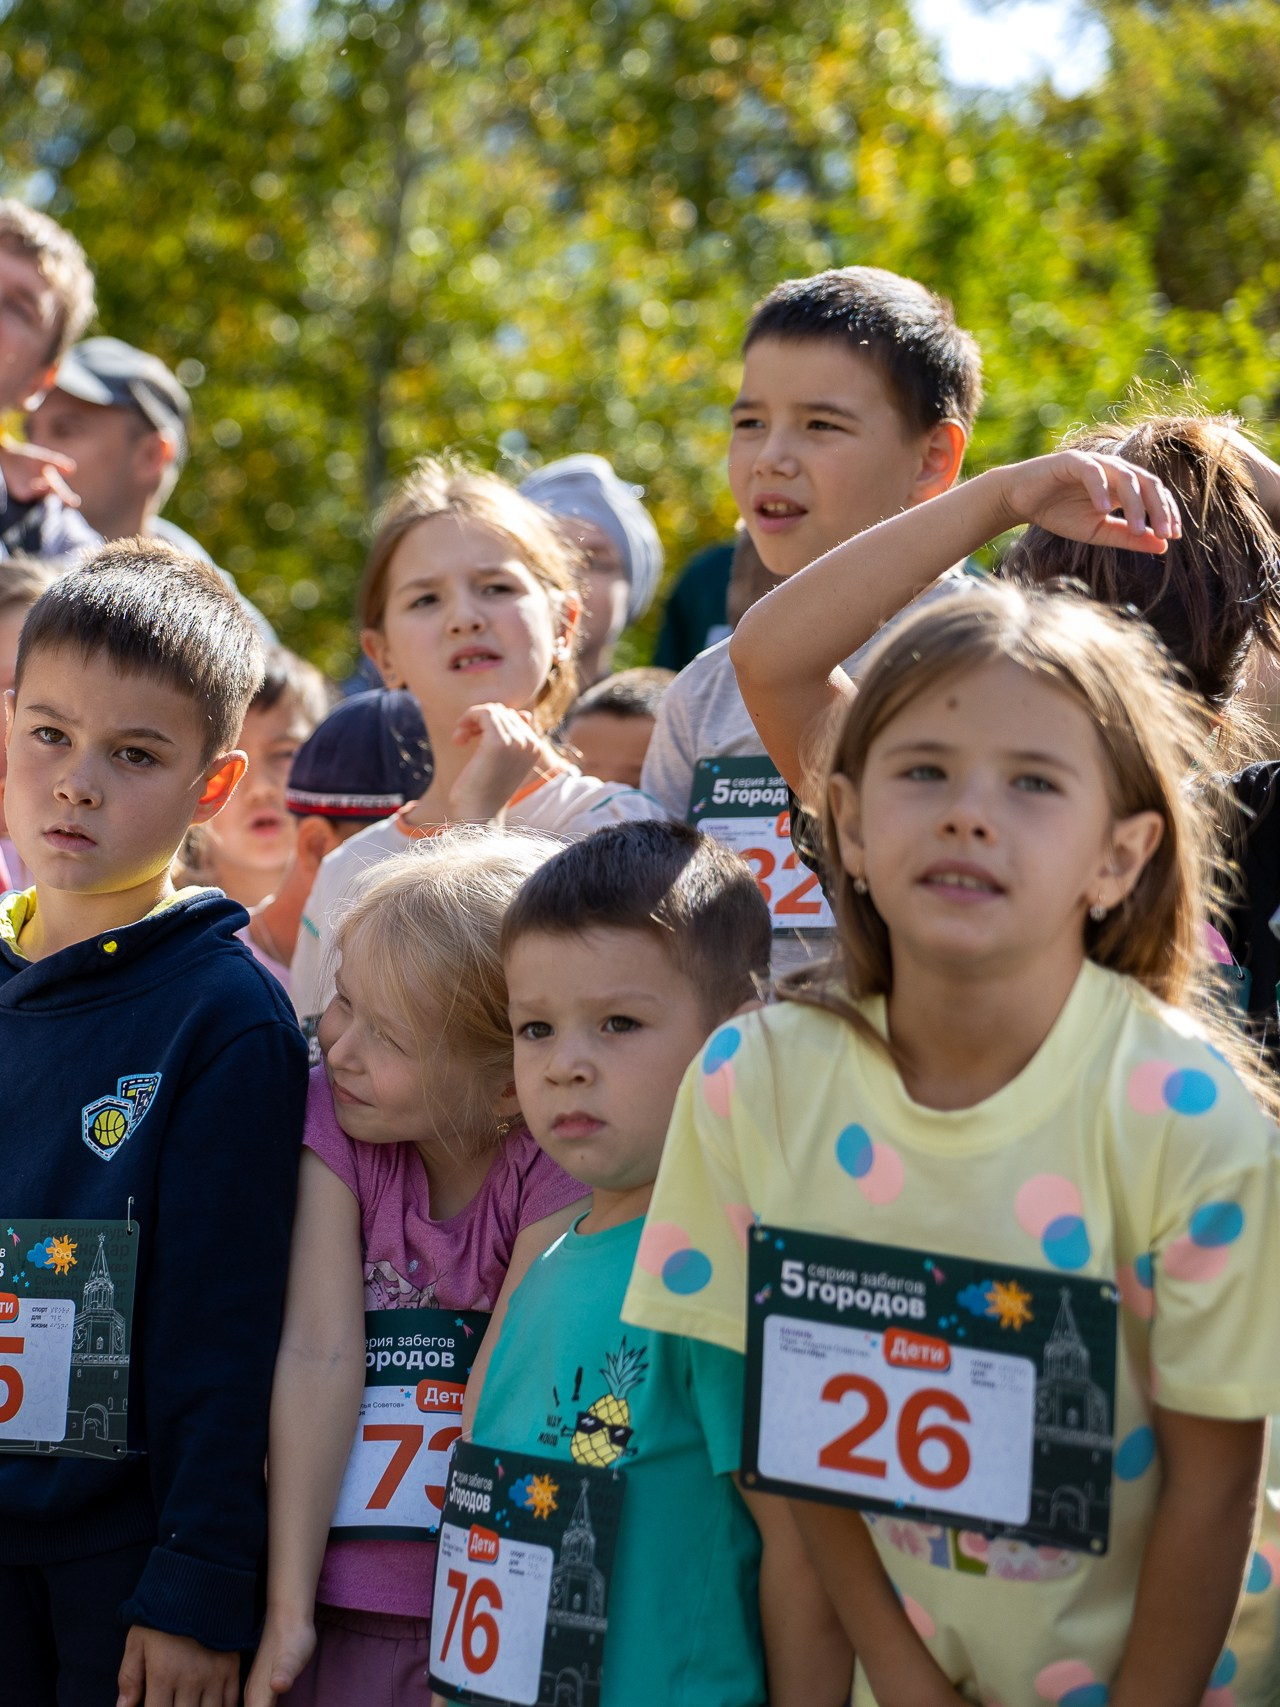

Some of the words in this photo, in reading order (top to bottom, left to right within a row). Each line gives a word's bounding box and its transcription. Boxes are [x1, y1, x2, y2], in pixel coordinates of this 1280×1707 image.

[712, 778, 731, 805] 5
[729, 788, 789, 807] город
[732, 776, 765, 788] серия
[780, 1260, 804, 1298] 5
[807, 1281, 927, 1320] городов
[807, 1264, 856, 1284] серия
[860, 1271, 926, 1296] забегов
[397, 1334, 455, 1348] забегов
[889, 1337, 945, 1364] Дети
[365, 1350, 455, 1371] ородов
[373, 1401, 405, 1409] Советов»
[818, 1372, 973, 1491] 26
[470, 1533, 496, 1555] Дети
[440, 1568, 503, 1676] 76
